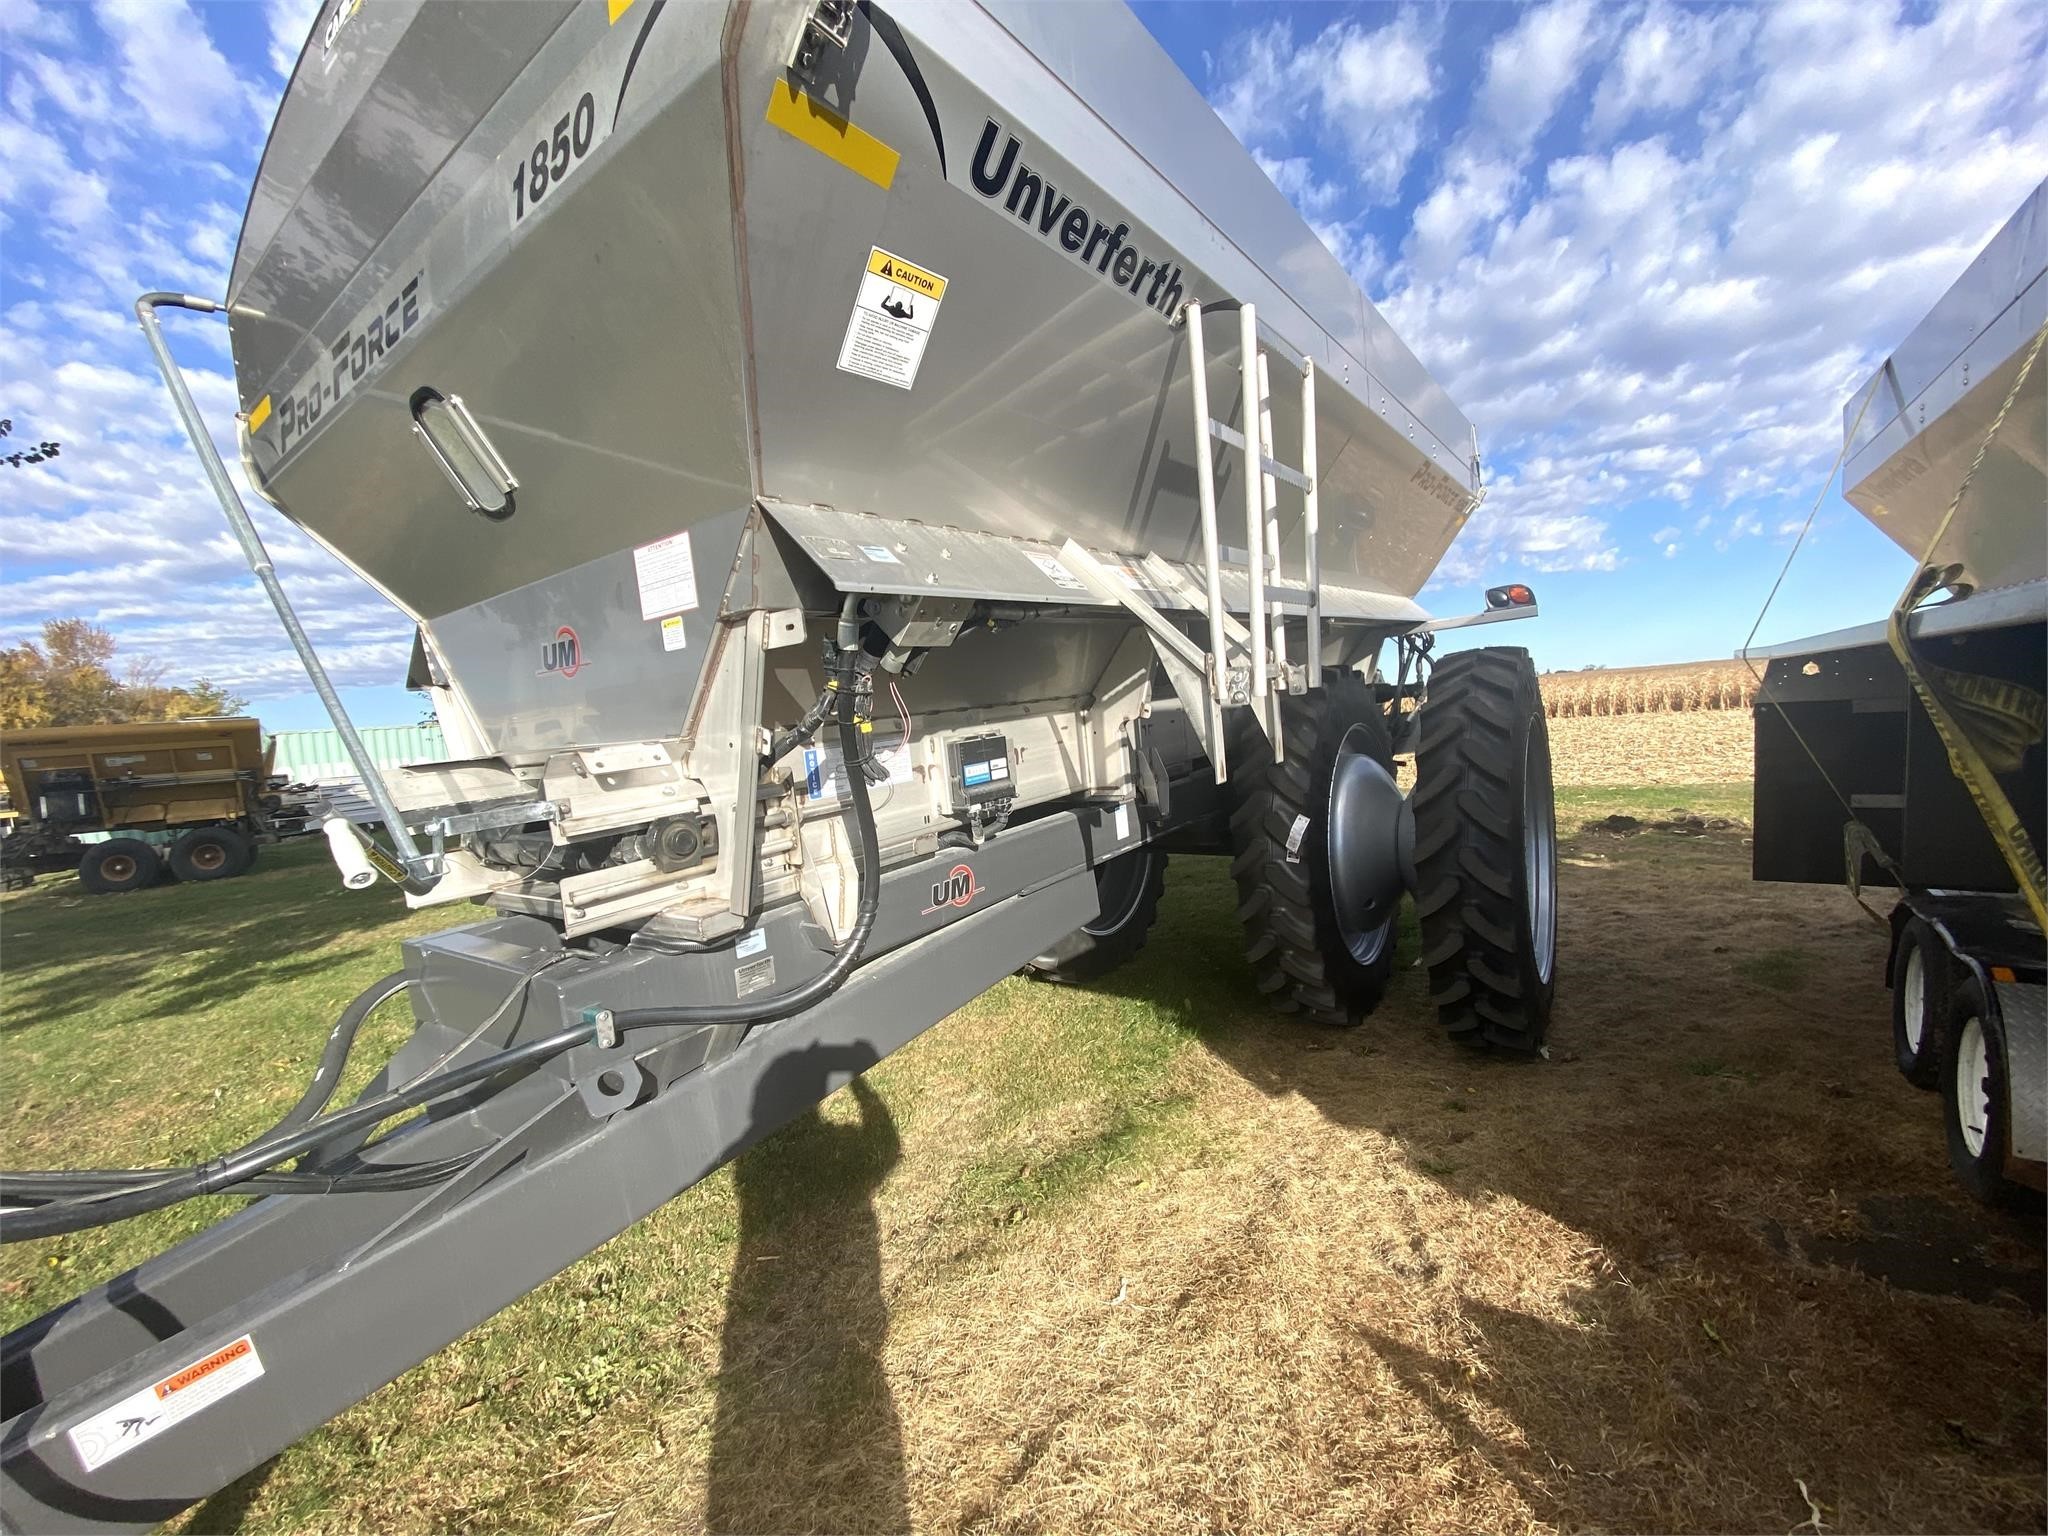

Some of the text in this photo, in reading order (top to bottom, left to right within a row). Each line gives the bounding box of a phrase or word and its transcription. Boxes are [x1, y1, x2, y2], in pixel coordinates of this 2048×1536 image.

[513, 92, 595, 221] 1850
[970, 116, 1184, 319] Unverferth
[895, 268, 934, 291] CAUTION
[279, 276, 419, 453] PRO-FORCE
[543, 639, 577, 671] UM
[807, 753, 819, 796] NOTICE
[932, 873, 970, 907] UM
[176, 1344, 247, 1385] WARNING
